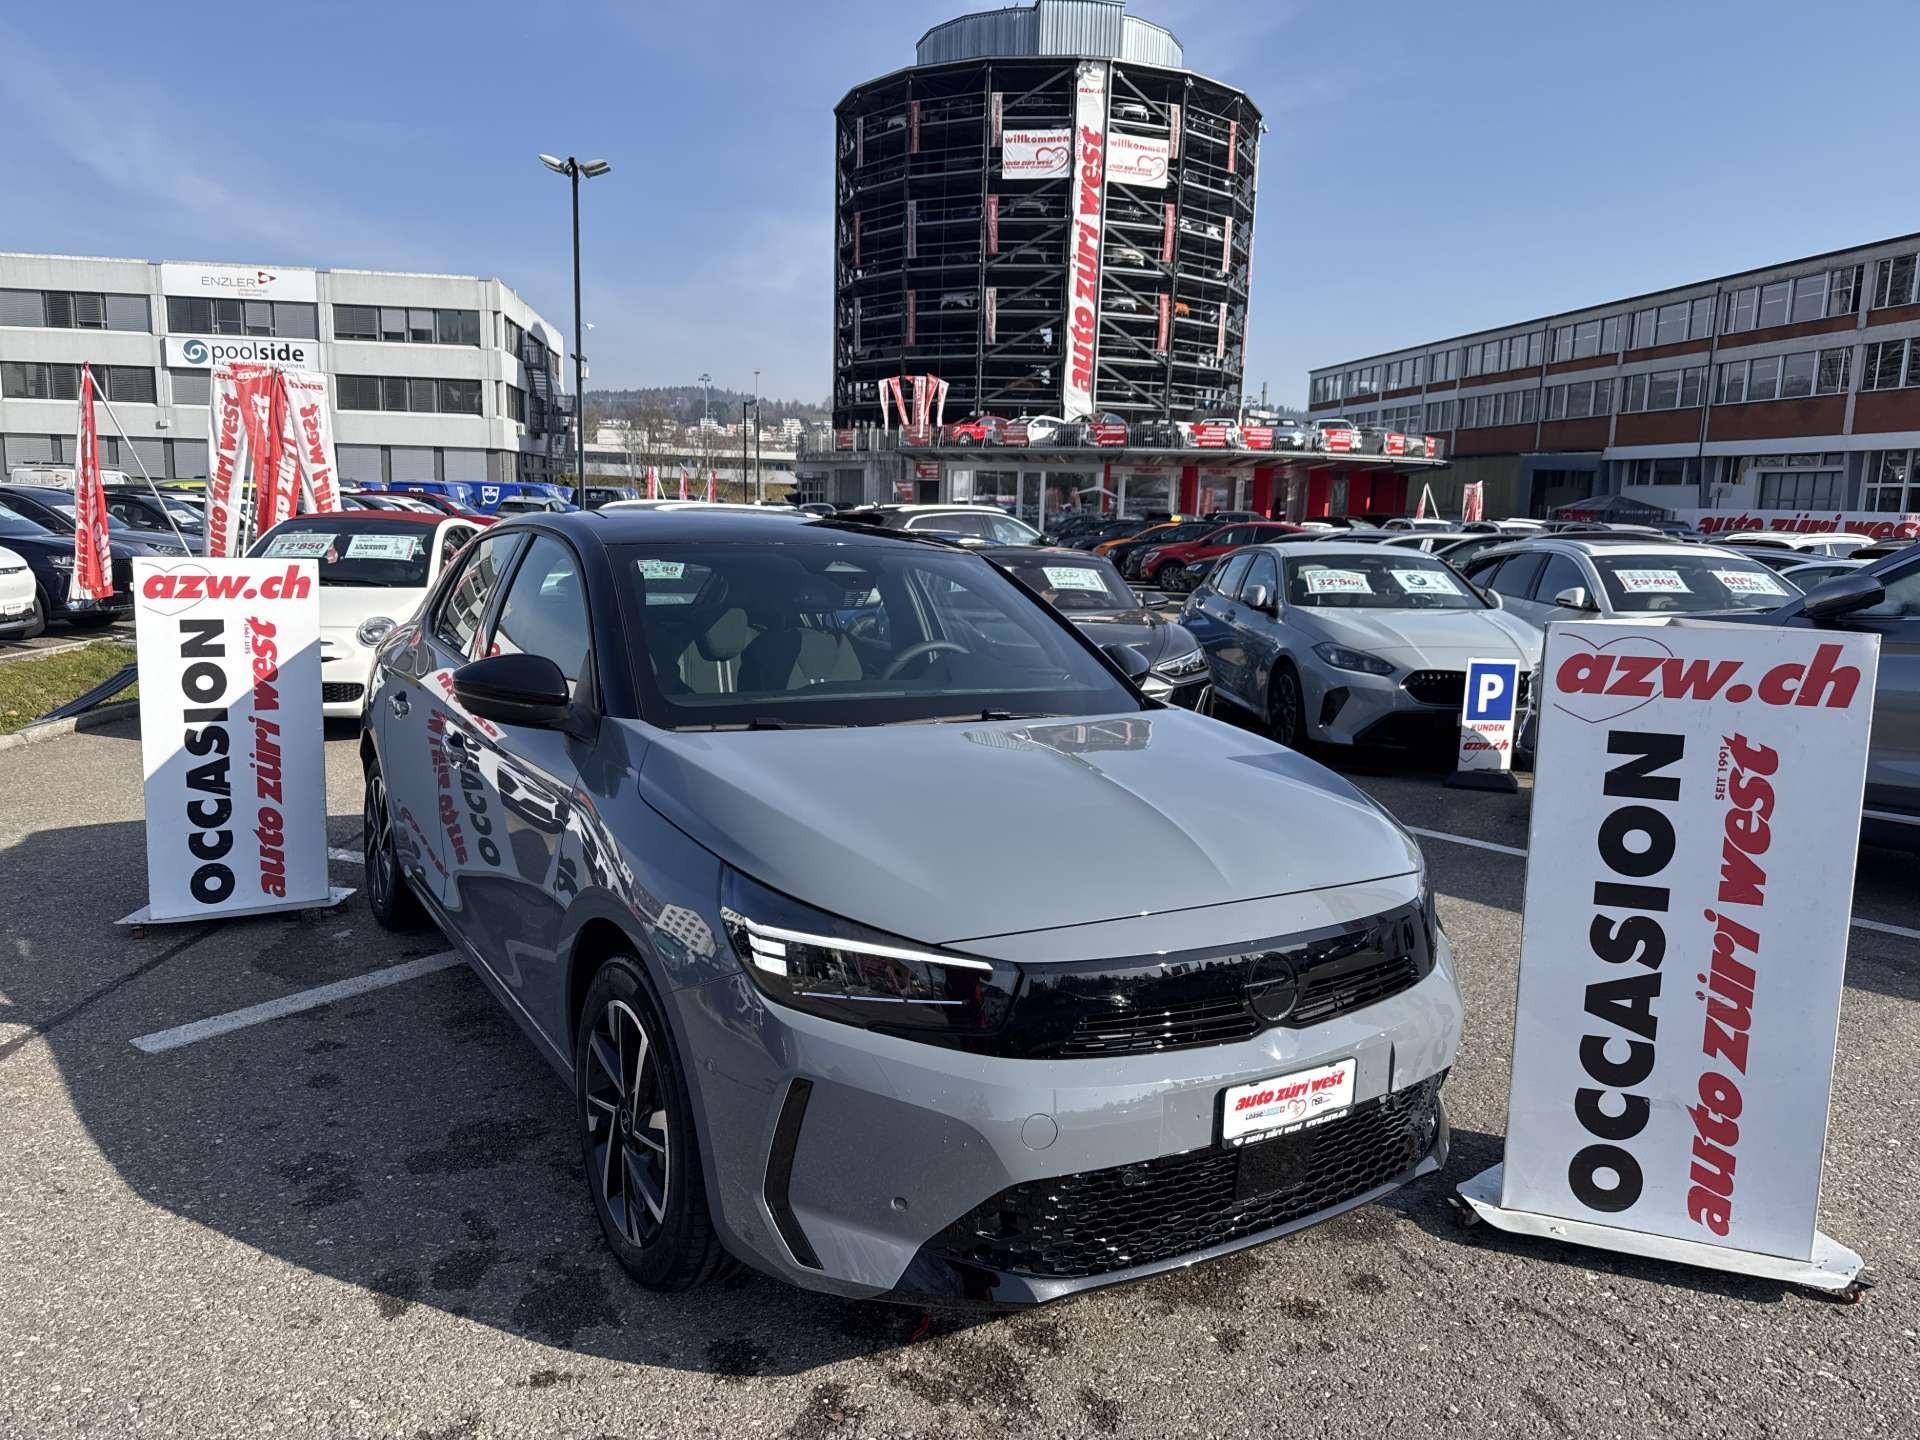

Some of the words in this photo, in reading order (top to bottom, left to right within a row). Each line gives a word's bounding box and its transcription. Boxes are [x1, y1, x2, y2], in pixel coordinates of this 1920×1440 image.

[1005, 134, 1070, 144] willkommen
[1110, 139, 1167, 153] willkommen
[1080, 125, 1103, 215] west
[202, 276, 256, 288] ENZLER
[1072, 219, 1099, 304] züri
[211, 342, 305, 365] poolside
[1070, 306, 1094, 393] auto
[219, 392, 240, 451] west
[211, 452, 236, 506] züri
[1696, 511, 1764, 535] auto
[143, 565, 311, 600] azw.ch
[245, 616, 280, 710] west
[1556, 644, 1861, 709] azw.ch
[1477, 673, 1504, 713] P
[1463, 739, 1509, 751] azw.ch
[1471, 724, 1505, 732] KUNDEN
[179, 618, 236, 904] OCCASION
[248, 715, 285, 804] züri
[1718, 746, 1731, 773] 1991
[1715, 777, 1728, 801] SEIT
[1718, 732, 1779, 906] west
[252, 806, 287, 898] auto
[1568, 730, 1685, 1213] OCCASION
[1695, 908, 1760, 1076] züri
[1235, 1090, 1275, 1111] auto
[1275, 1079, 1311, 1102] züri
[1311, 1070, 1345, 1093] west
[1244, 1133, 1264, 1145] auto
[1284, 1121, 1303, 1134] west
[1686, 1072, 1742, 1236] auto
